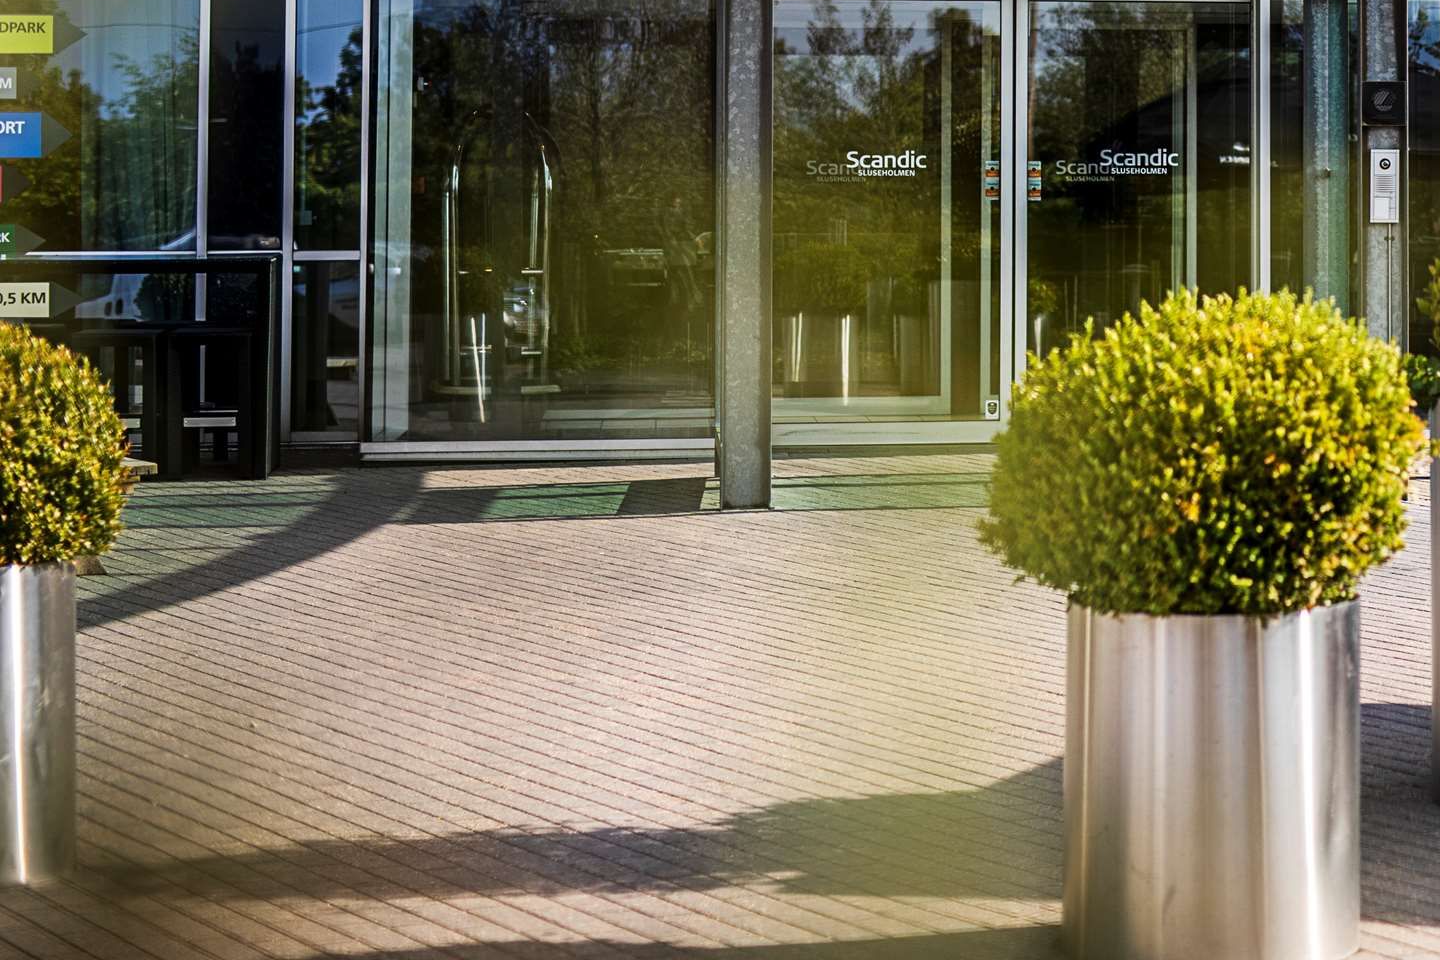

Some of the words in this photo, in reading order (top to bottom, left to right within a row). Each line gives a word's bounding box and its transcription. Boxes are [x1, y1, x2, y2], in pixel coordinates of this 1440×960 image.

[846, 150, 927, 169] Scandic
[1099, 148, 1179, 167] Scandic
[857, 169, 917, 177] SLUSEHOLMEN
[1110, 167, 1168, 175] SLUSEHOLMEN
[21, 292, 46, 304] KM
